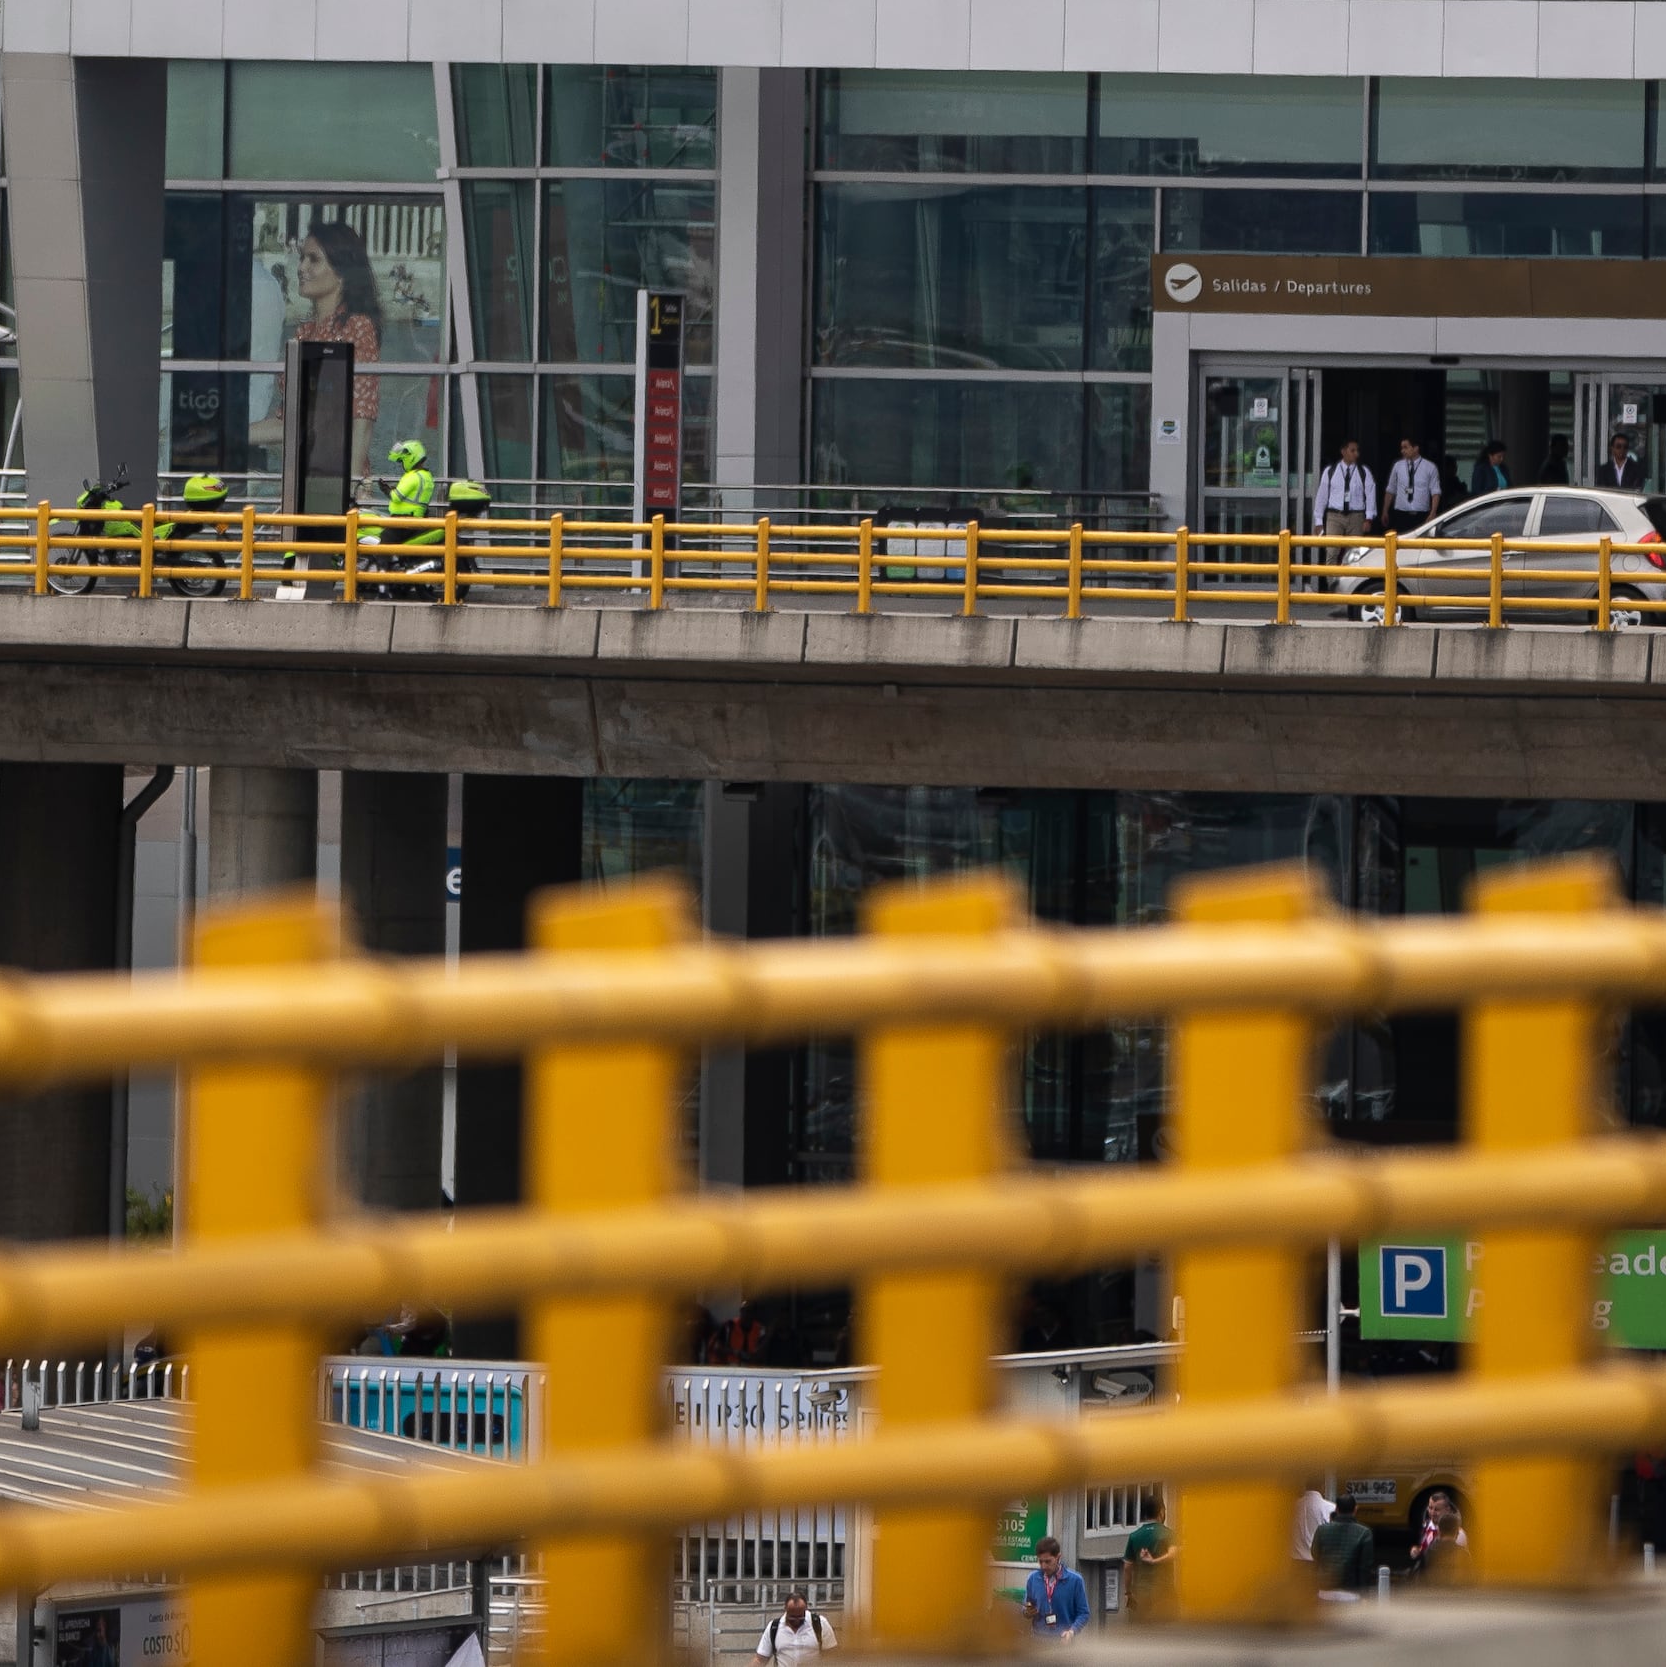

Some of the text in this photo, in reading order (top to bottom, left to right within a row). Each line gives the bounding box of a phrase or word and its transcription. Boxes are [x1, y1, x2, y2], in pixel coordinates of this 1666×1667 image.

[1213, 278, 1267, 293] Salidas
[1286, 280, 1372, 297] Departures
[1394, 1254, 1432, 1308] P
[143, 1635, 173, 1656] COSTO
